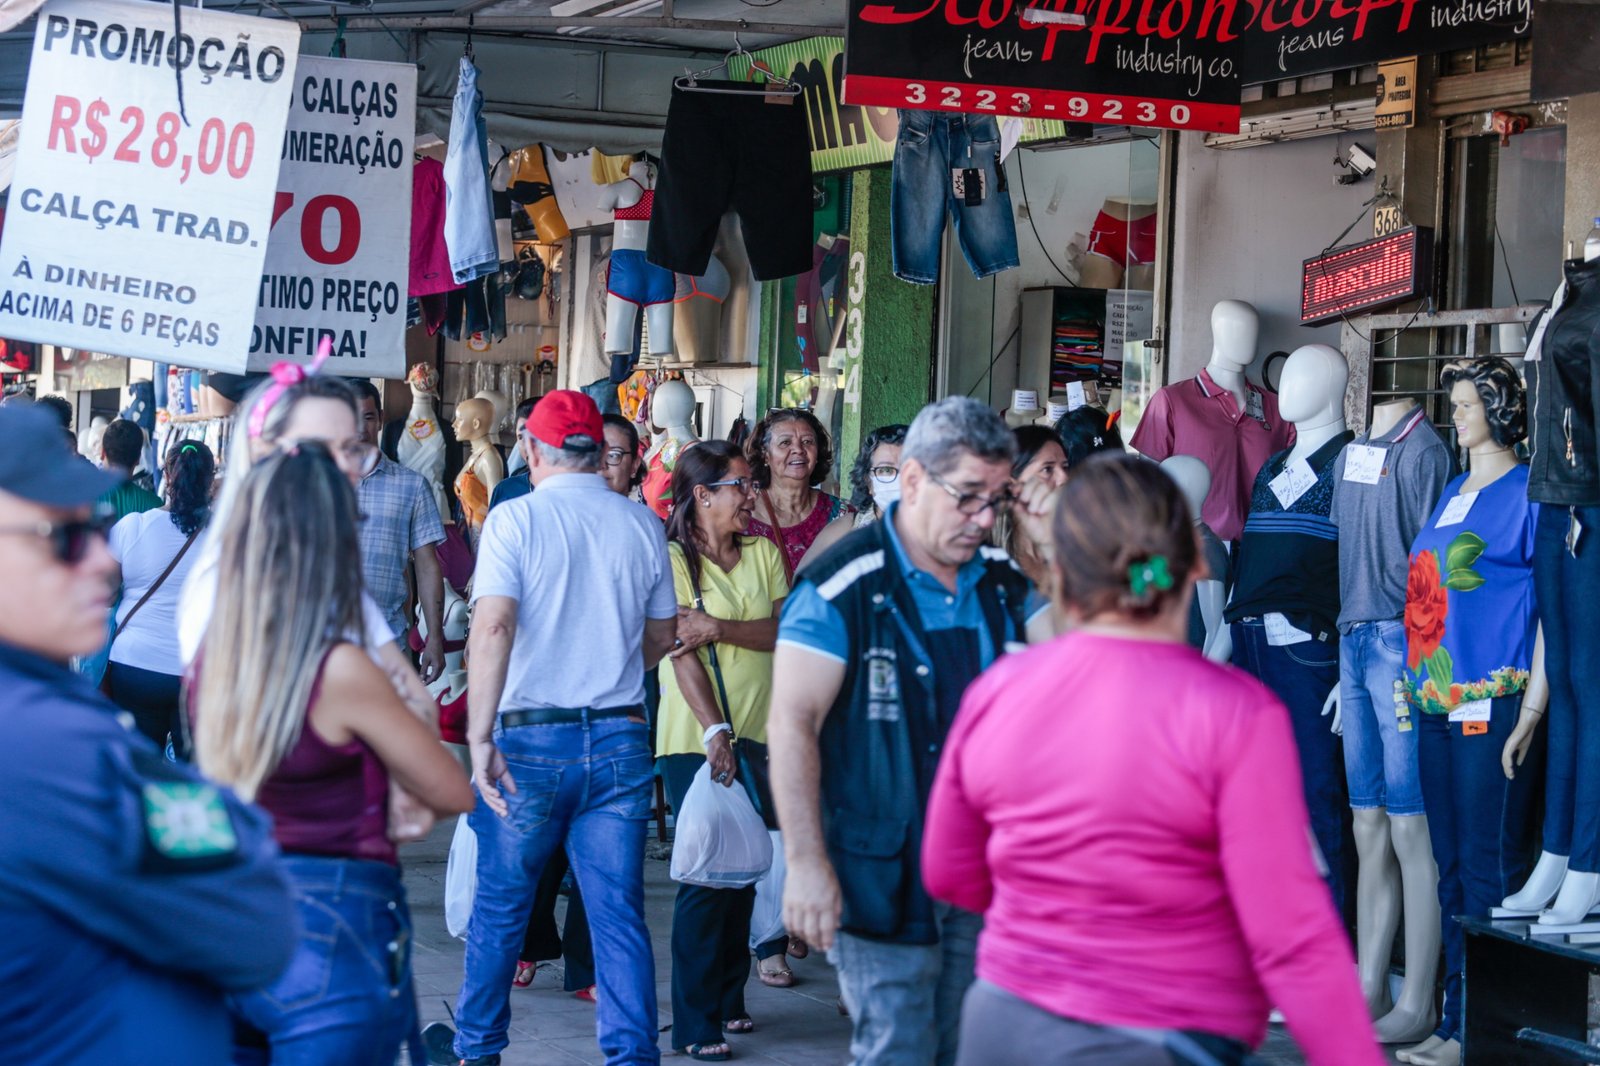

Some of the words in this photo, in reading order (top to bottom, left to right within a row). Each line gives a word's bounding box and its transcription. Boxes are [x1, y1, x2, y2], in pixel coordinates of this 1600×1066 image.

[43, 14, 285, 84] PROMOÇÃO
[963, 34, 1033, 79] jeans
[1116, 37, 1203, 97] industry
[1208, 56, 1238, 79] co.
[1278, 27, 1344, 72] jeans
[302, 75, 398, 126] CALÇAS
[20, 187, 140, 230] CALÇA
[153, 207, 259, 248] TRAD.
[1375, 209, 1399, 236] 368
[12, 255, 33, 279] À
[44, 263, 197, 305] DINHEIRO
[322, 277, 399, 323] PREÇO
[0, 289, 74, 325] ACIMA
[83, 302, 113, 330] DE
[121, 308, 134, 333] 6
[141, 312, 220, 348] PEÇAS
